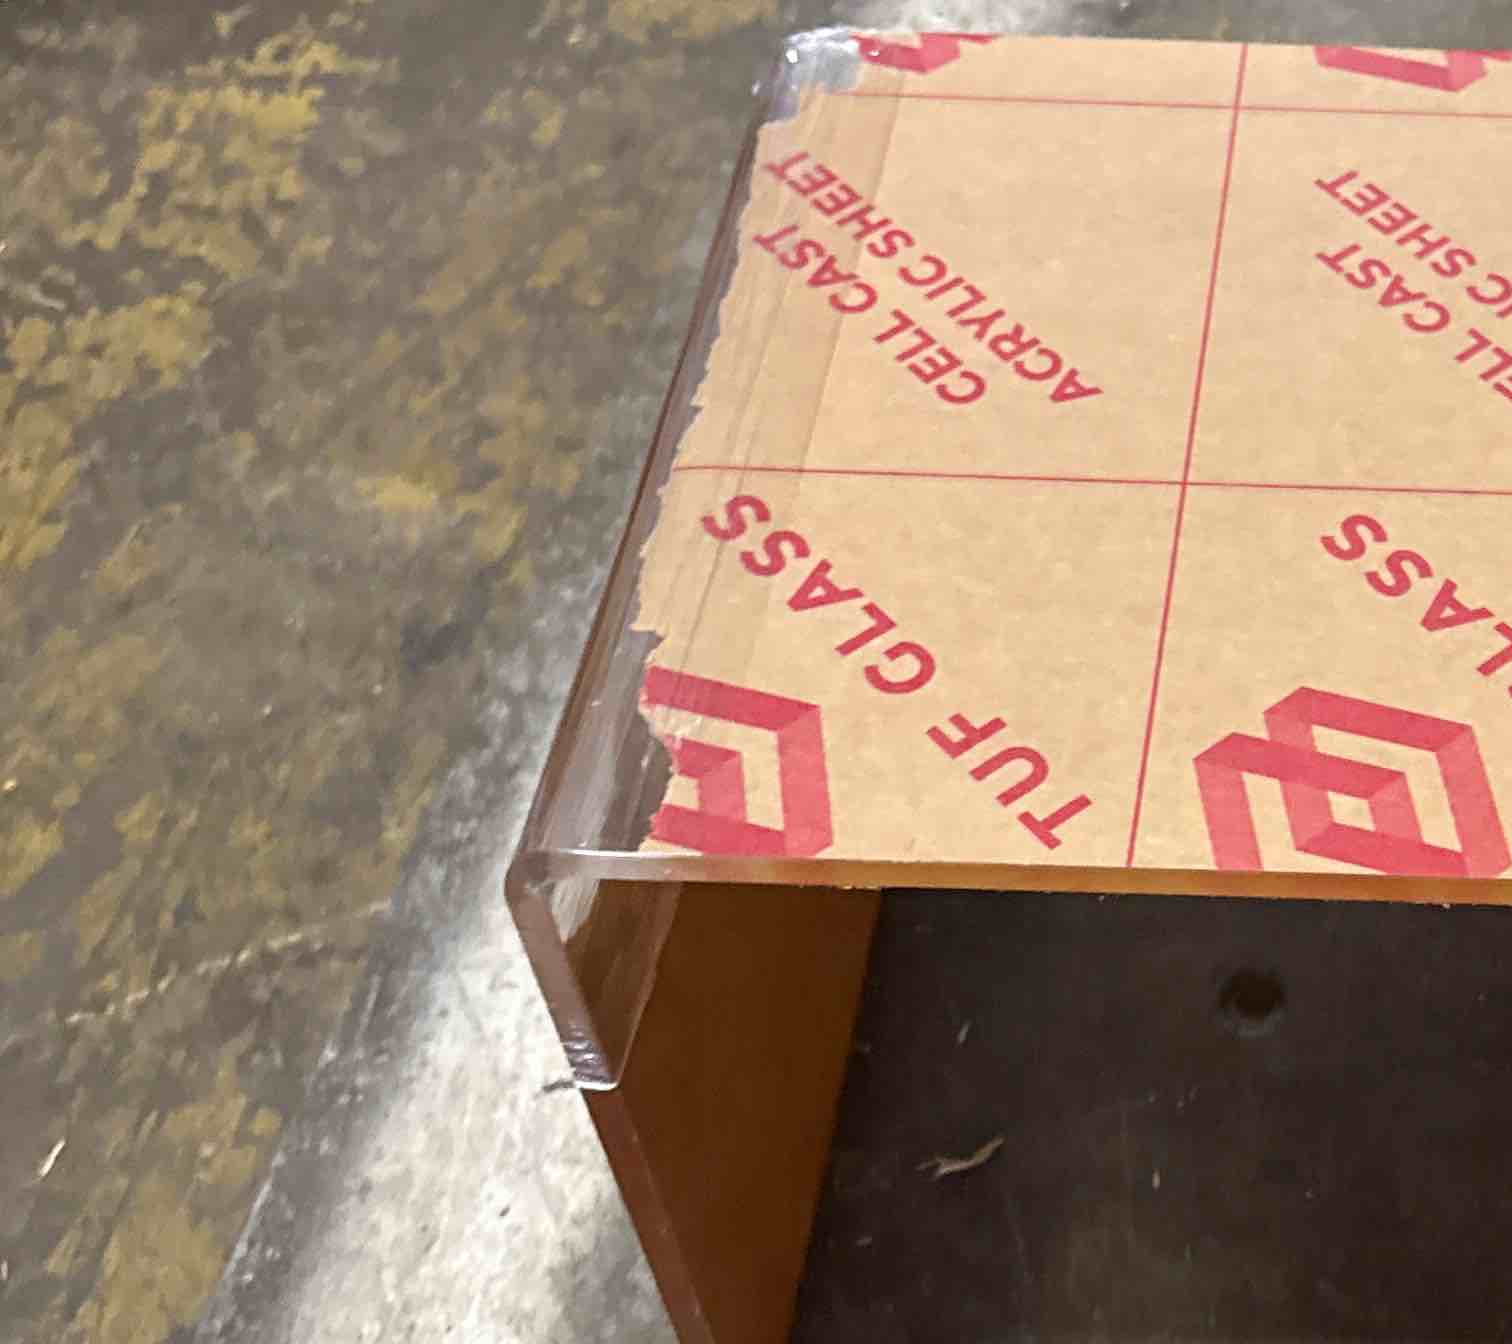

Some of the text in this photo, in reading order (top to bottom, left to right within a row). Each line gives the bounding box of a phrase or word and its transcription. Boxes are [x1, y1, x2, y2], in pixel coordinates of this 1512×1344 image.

[753, 223, 988, 405] CELL CAST
[766, 151, 1103, 404] ACRYLIC SHEET
[1315, 169, 1475, 278] SHEET
[1317, 242, 1451, 333] CAST
[702, 494, 1093, 850] TUF GLASS
